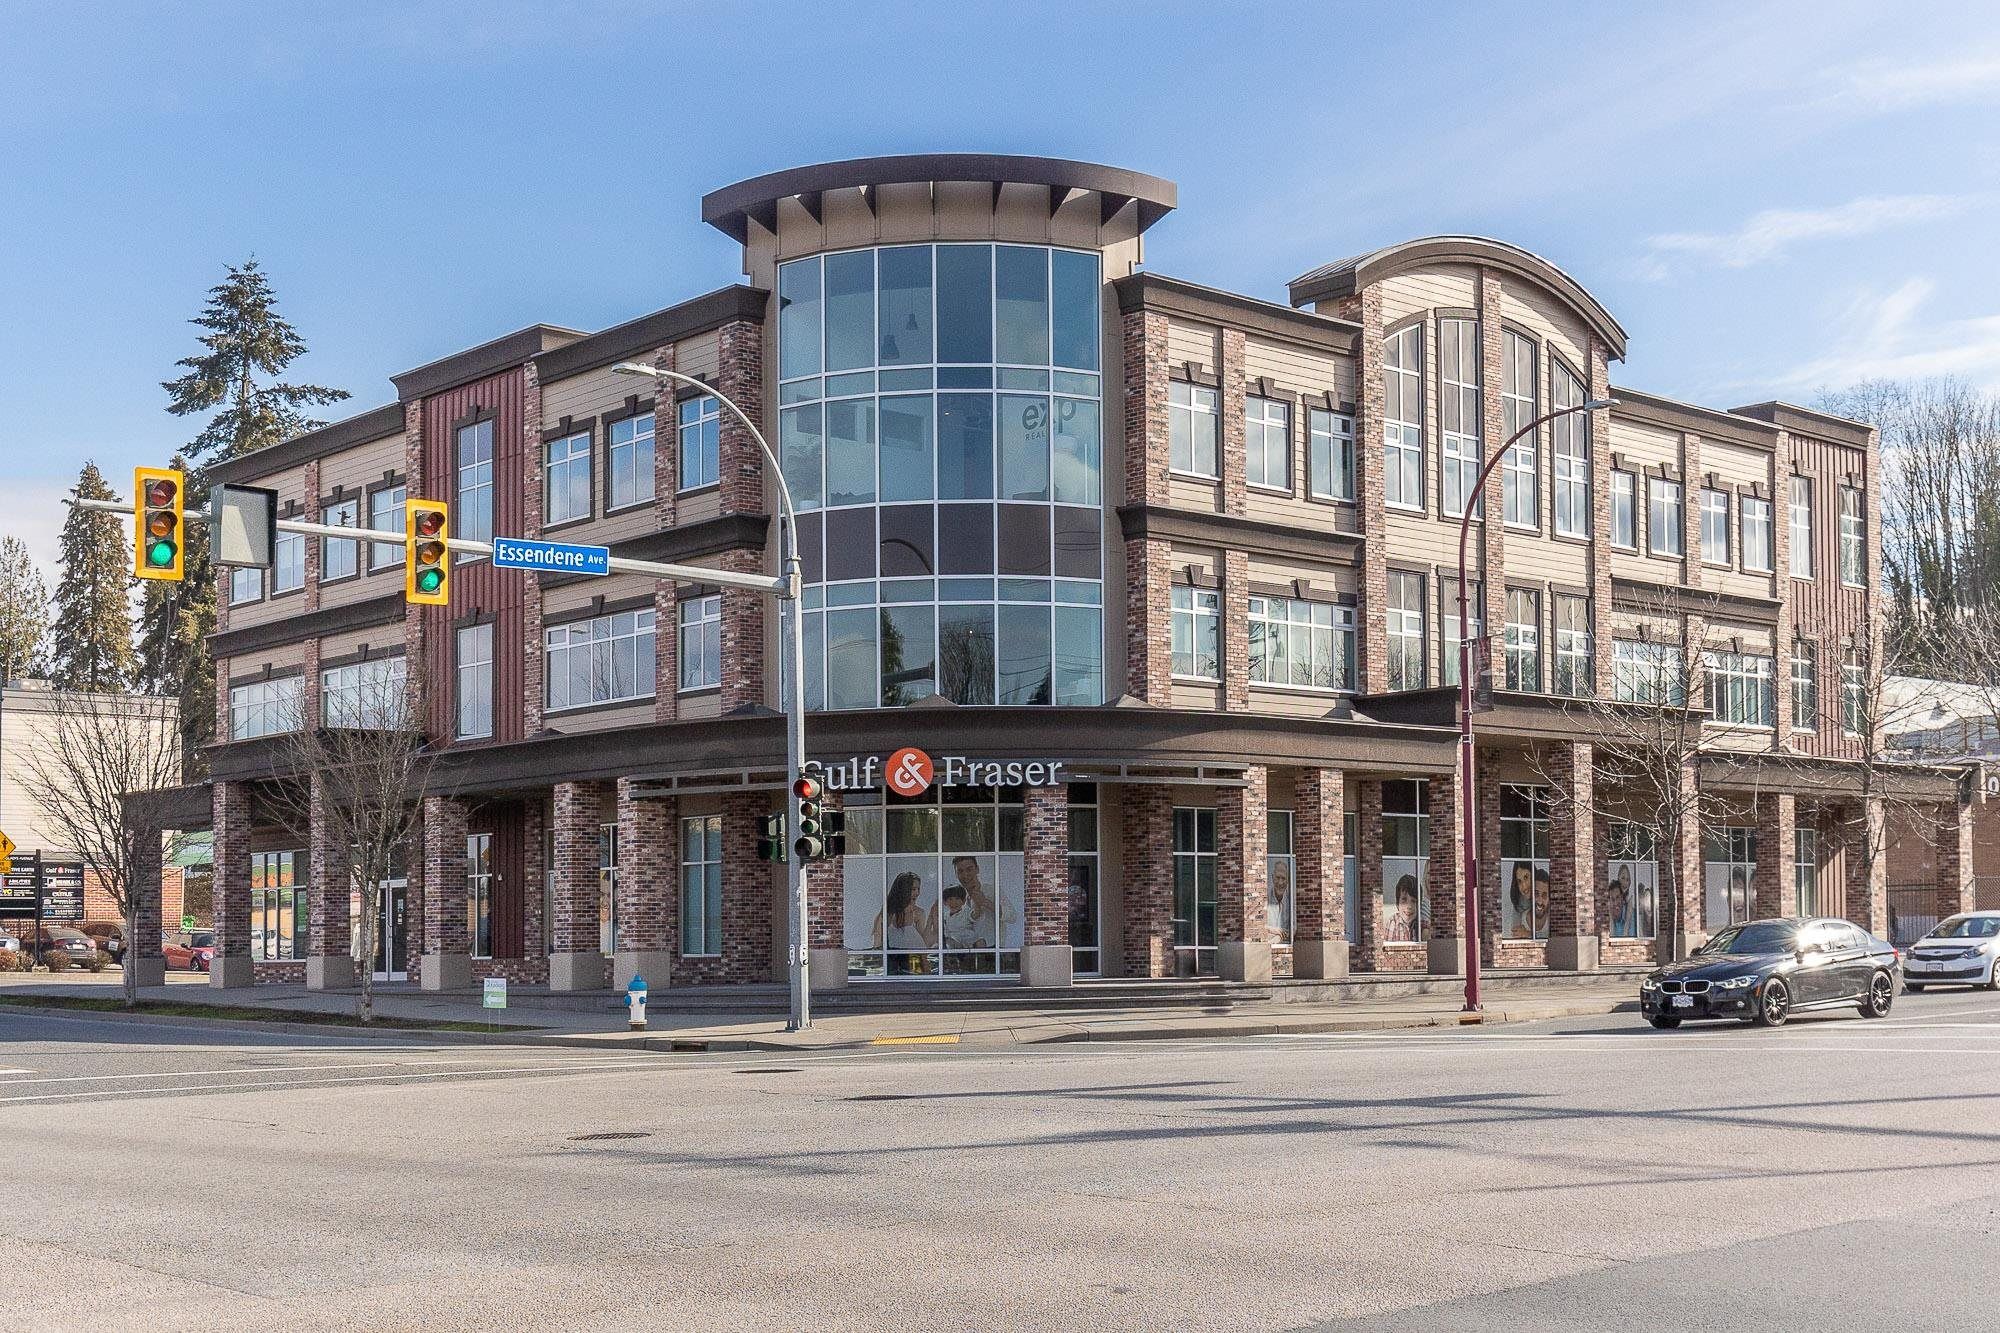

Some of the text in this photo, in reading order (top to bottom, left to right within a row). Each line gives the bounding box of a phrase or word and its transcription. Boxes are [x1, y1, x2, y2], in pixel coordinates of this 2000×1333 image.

[499, 543, 584, 567] Essendene
[894, 752, 929, 789] &
[942, 756, 1062, 788] Fraser
